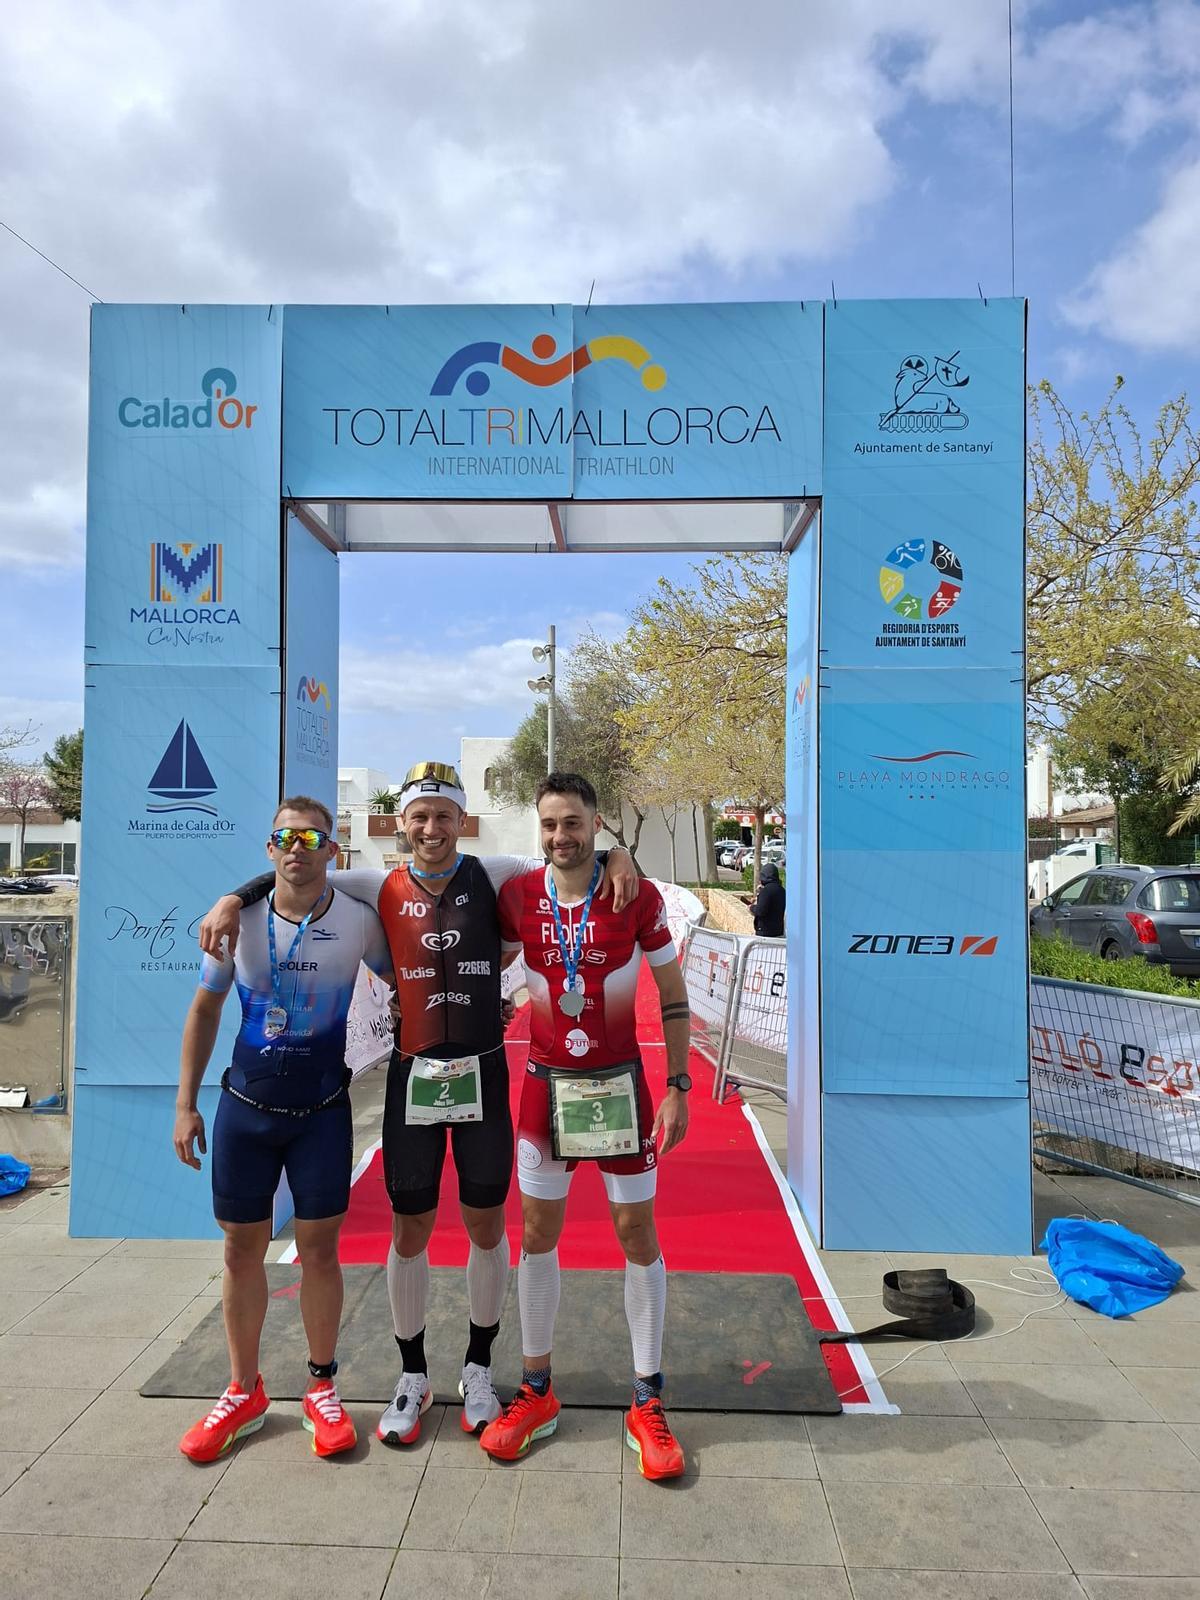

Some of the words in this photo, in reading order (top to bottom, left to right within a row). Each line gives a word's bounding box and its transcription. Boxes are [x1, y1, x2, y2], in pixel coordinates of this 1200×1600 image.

[321, 405, 782, 447] TOTALTRIMALLORCA
[853, 442, 922, 454] Ajuntament
[926, 442, 940, 453] de
[943, 440, 994, 453] Santanyí
[428, 456, 565, 476] INTERNATIONAL
[576, 456, 675, 476] TRIATHLON
[130, 608, 241, 625] MALLORCA
[147, 627, 172, 647] Ca
[173, 628, 225, 647] Nostra
[882, 623, 920, 634] REGIDORIA
[921, 623, 960, 634] D'ESPORTS
[875, 636, 920, 647] AJUNTAMENT
[921, 636, 931, 647] DE
[931, 634, 966, 647] SANTANYÍ
[838, 771, 891, 783] PLAYA
[128, 820, 168, 831] Marina
[171, 820, 184, 831] de
[186, 820, 210, 831] Cala
[212, 820, 235, 831] d'Or
[104, 906, 179, 960] Porto
[541, 921, 596, 945] FLORIT
[848, 934, 955, 955] ZONE3
[140, 963, 201, 971] RESTAURAN
[278, 961, 318, 972] SOLER
[400, 967, 436, 980] Tudis
[425, 991, 472, 1011] ZOGGS
[439, 1082, 450, 1100] 2
[591, 1101, 605, 1123] 3
